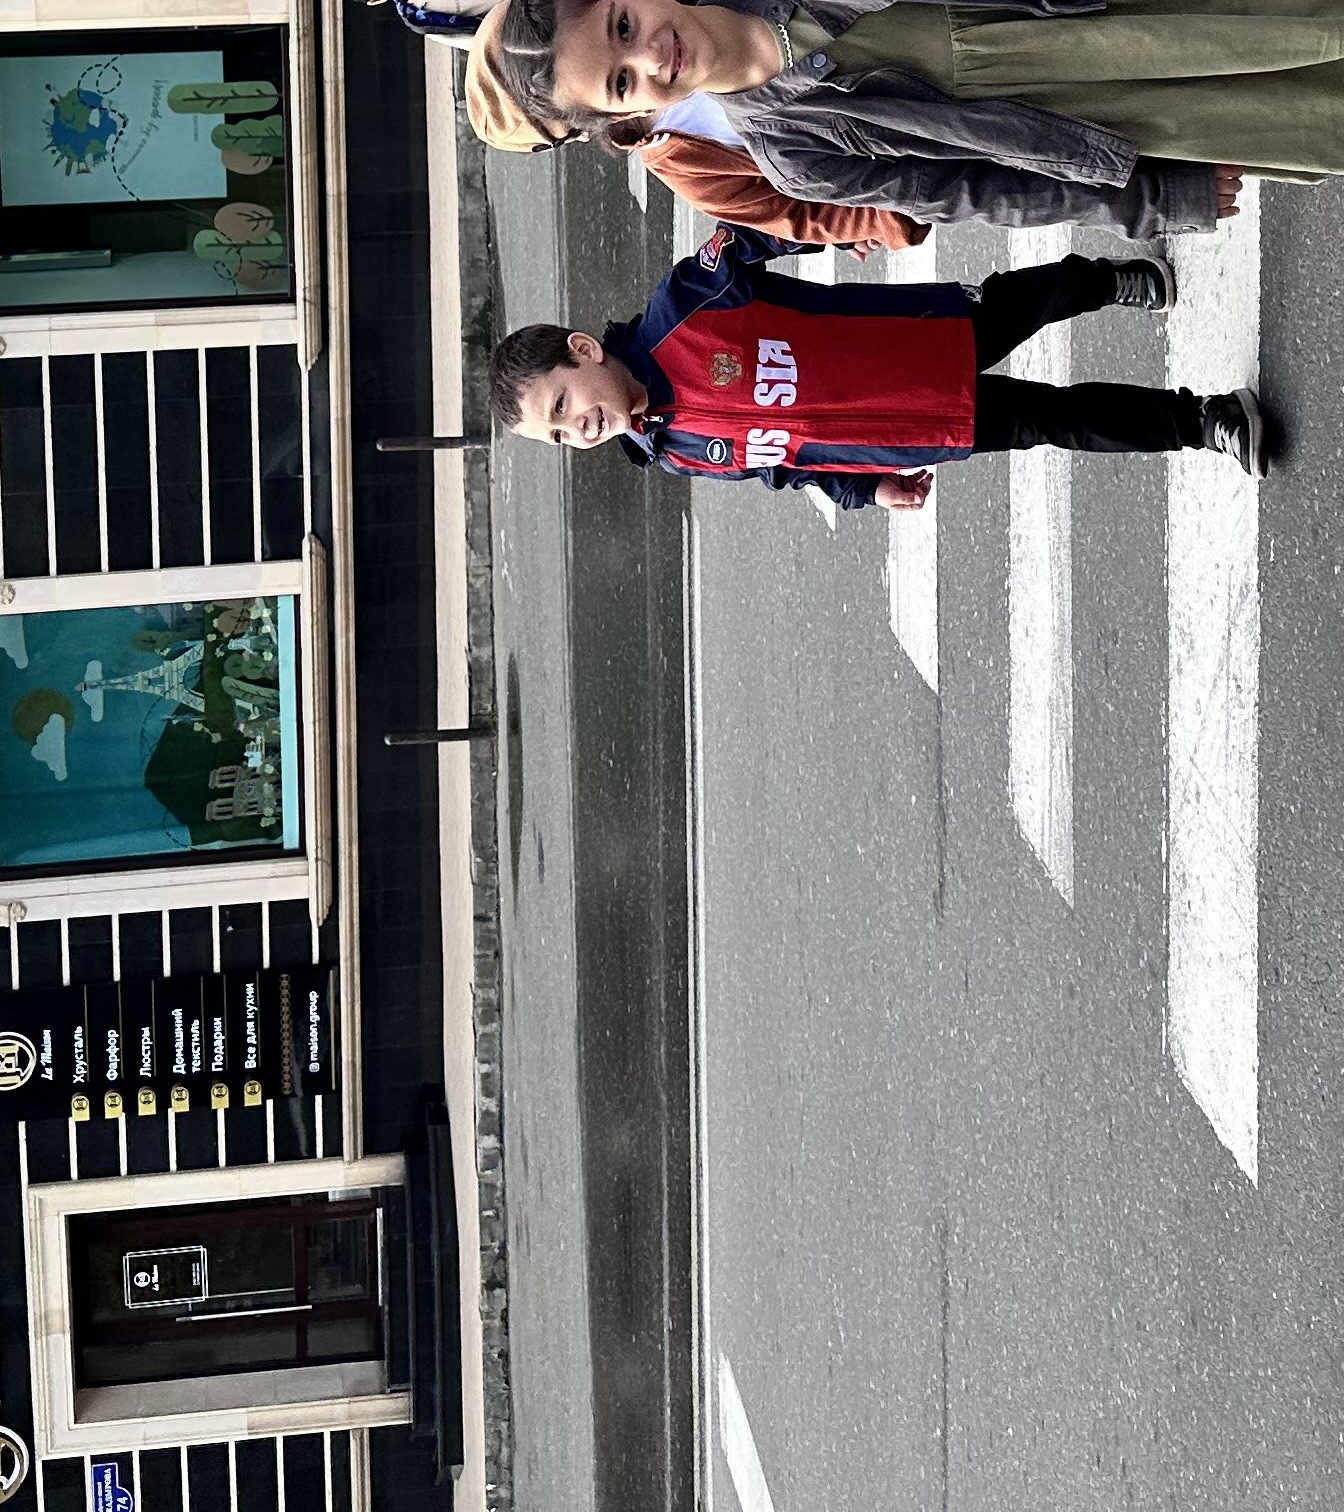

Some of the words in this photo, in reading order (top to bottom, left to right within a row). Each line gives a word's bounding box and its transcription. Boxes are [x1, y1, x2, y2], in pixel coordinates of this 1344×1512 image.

[245, 983, 258, 1019] кухни
[72, 1025, 87, 1083] Хрусталь
[106, 1030, 120, 1081] Фарфор
[139, 1027, 153, 1077] Люстры
[172, 1008, 186, 1074] Домашний
[190, 1019, 201, 1073] текстиль
[212, 1017, 225, 1072] Подарки
[245, 1021, 257, 1044] для
[244, 1047, 256, 1069] Все
[117, 1497, 128, 1511] 74
